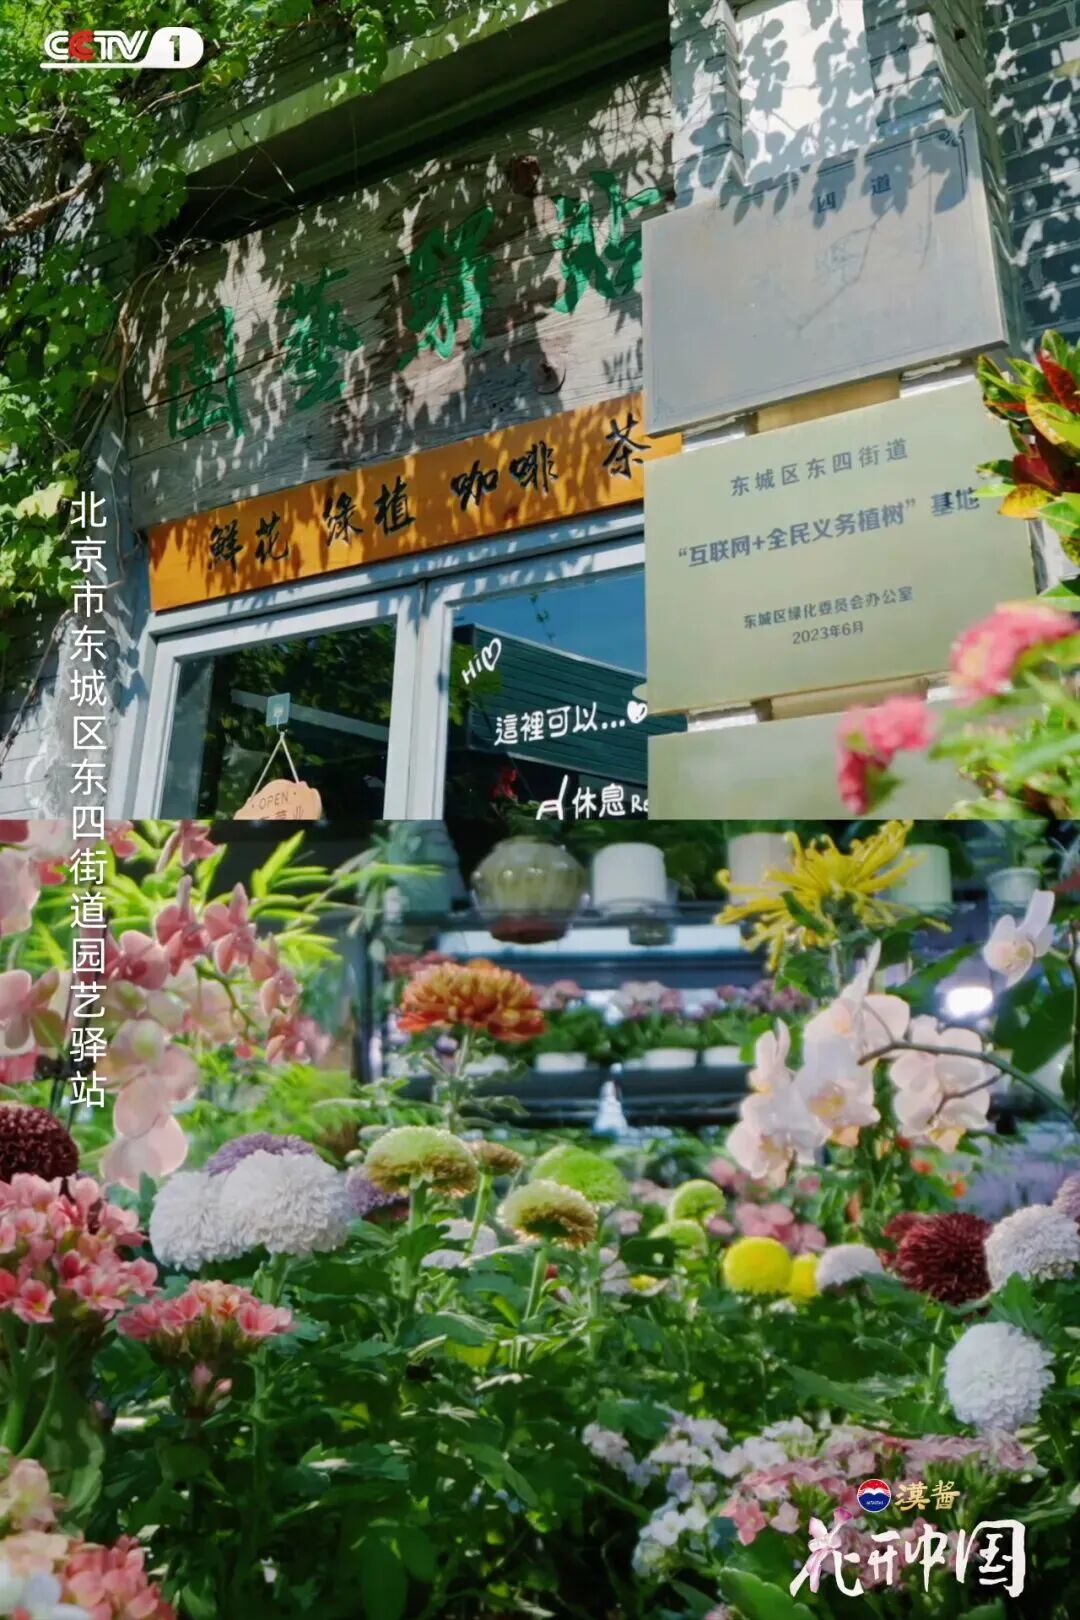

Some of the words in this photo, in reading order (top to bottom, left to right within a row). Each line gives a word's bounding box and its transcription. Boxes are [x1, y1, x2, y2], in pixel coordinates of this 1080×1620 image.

[450, 440, 559, 512] 咖啡
[602, 411, 652, 480] 茶
[730, 438, 908, 497] 东城区东四街道
[930, 487, 980, 517] 基地
[743, 586, 914, 630] 东城区绿化委员会办公室
[792, 620, 865, 645] 2023年6月
[258, 791, 289, 810] OPEN
[571, 783, 627, 820] 休息
